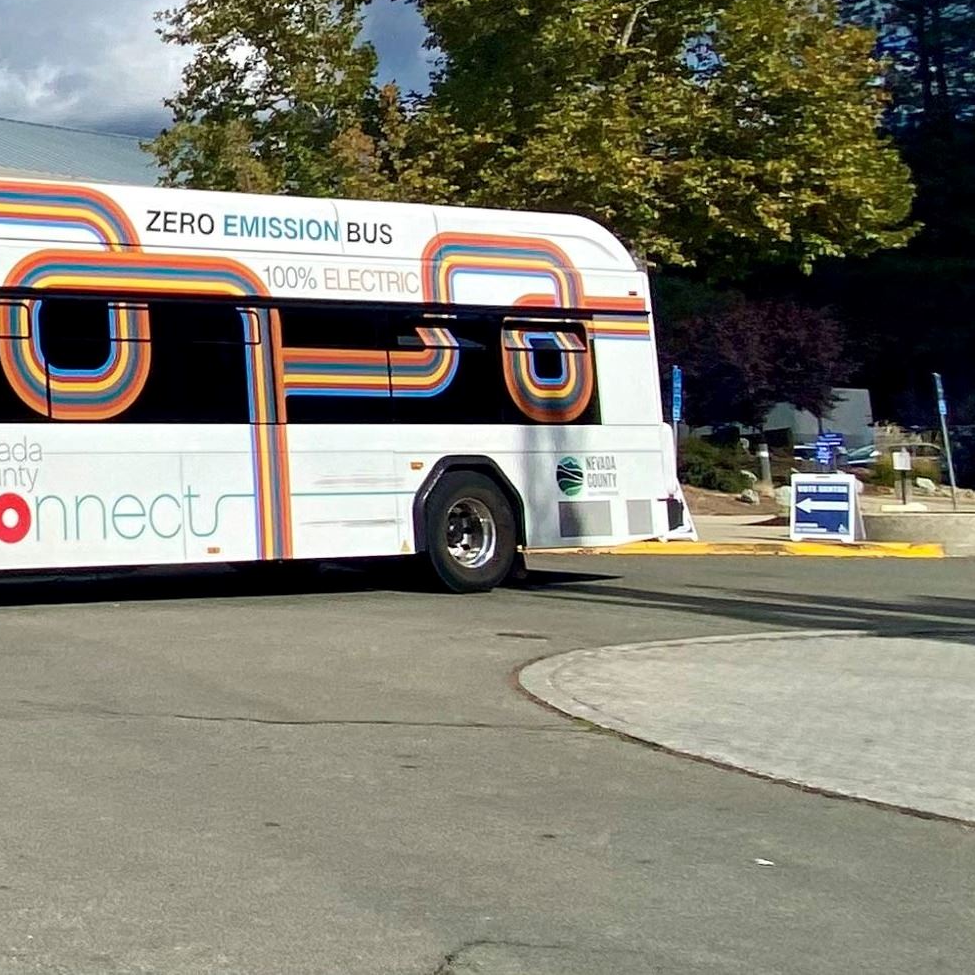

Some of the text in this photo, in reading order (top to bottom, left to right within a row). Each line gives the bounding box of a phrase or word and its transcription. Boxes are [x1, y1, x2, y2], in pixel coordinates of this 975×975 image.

[145, 210, 393, 245] ZERO EMISSION BUS
[263, 265, 420, 294] 100% ELECTRIC
[586, 455, 617, 470] NEVADA
[587, 473, 617, 488] COUNTY
